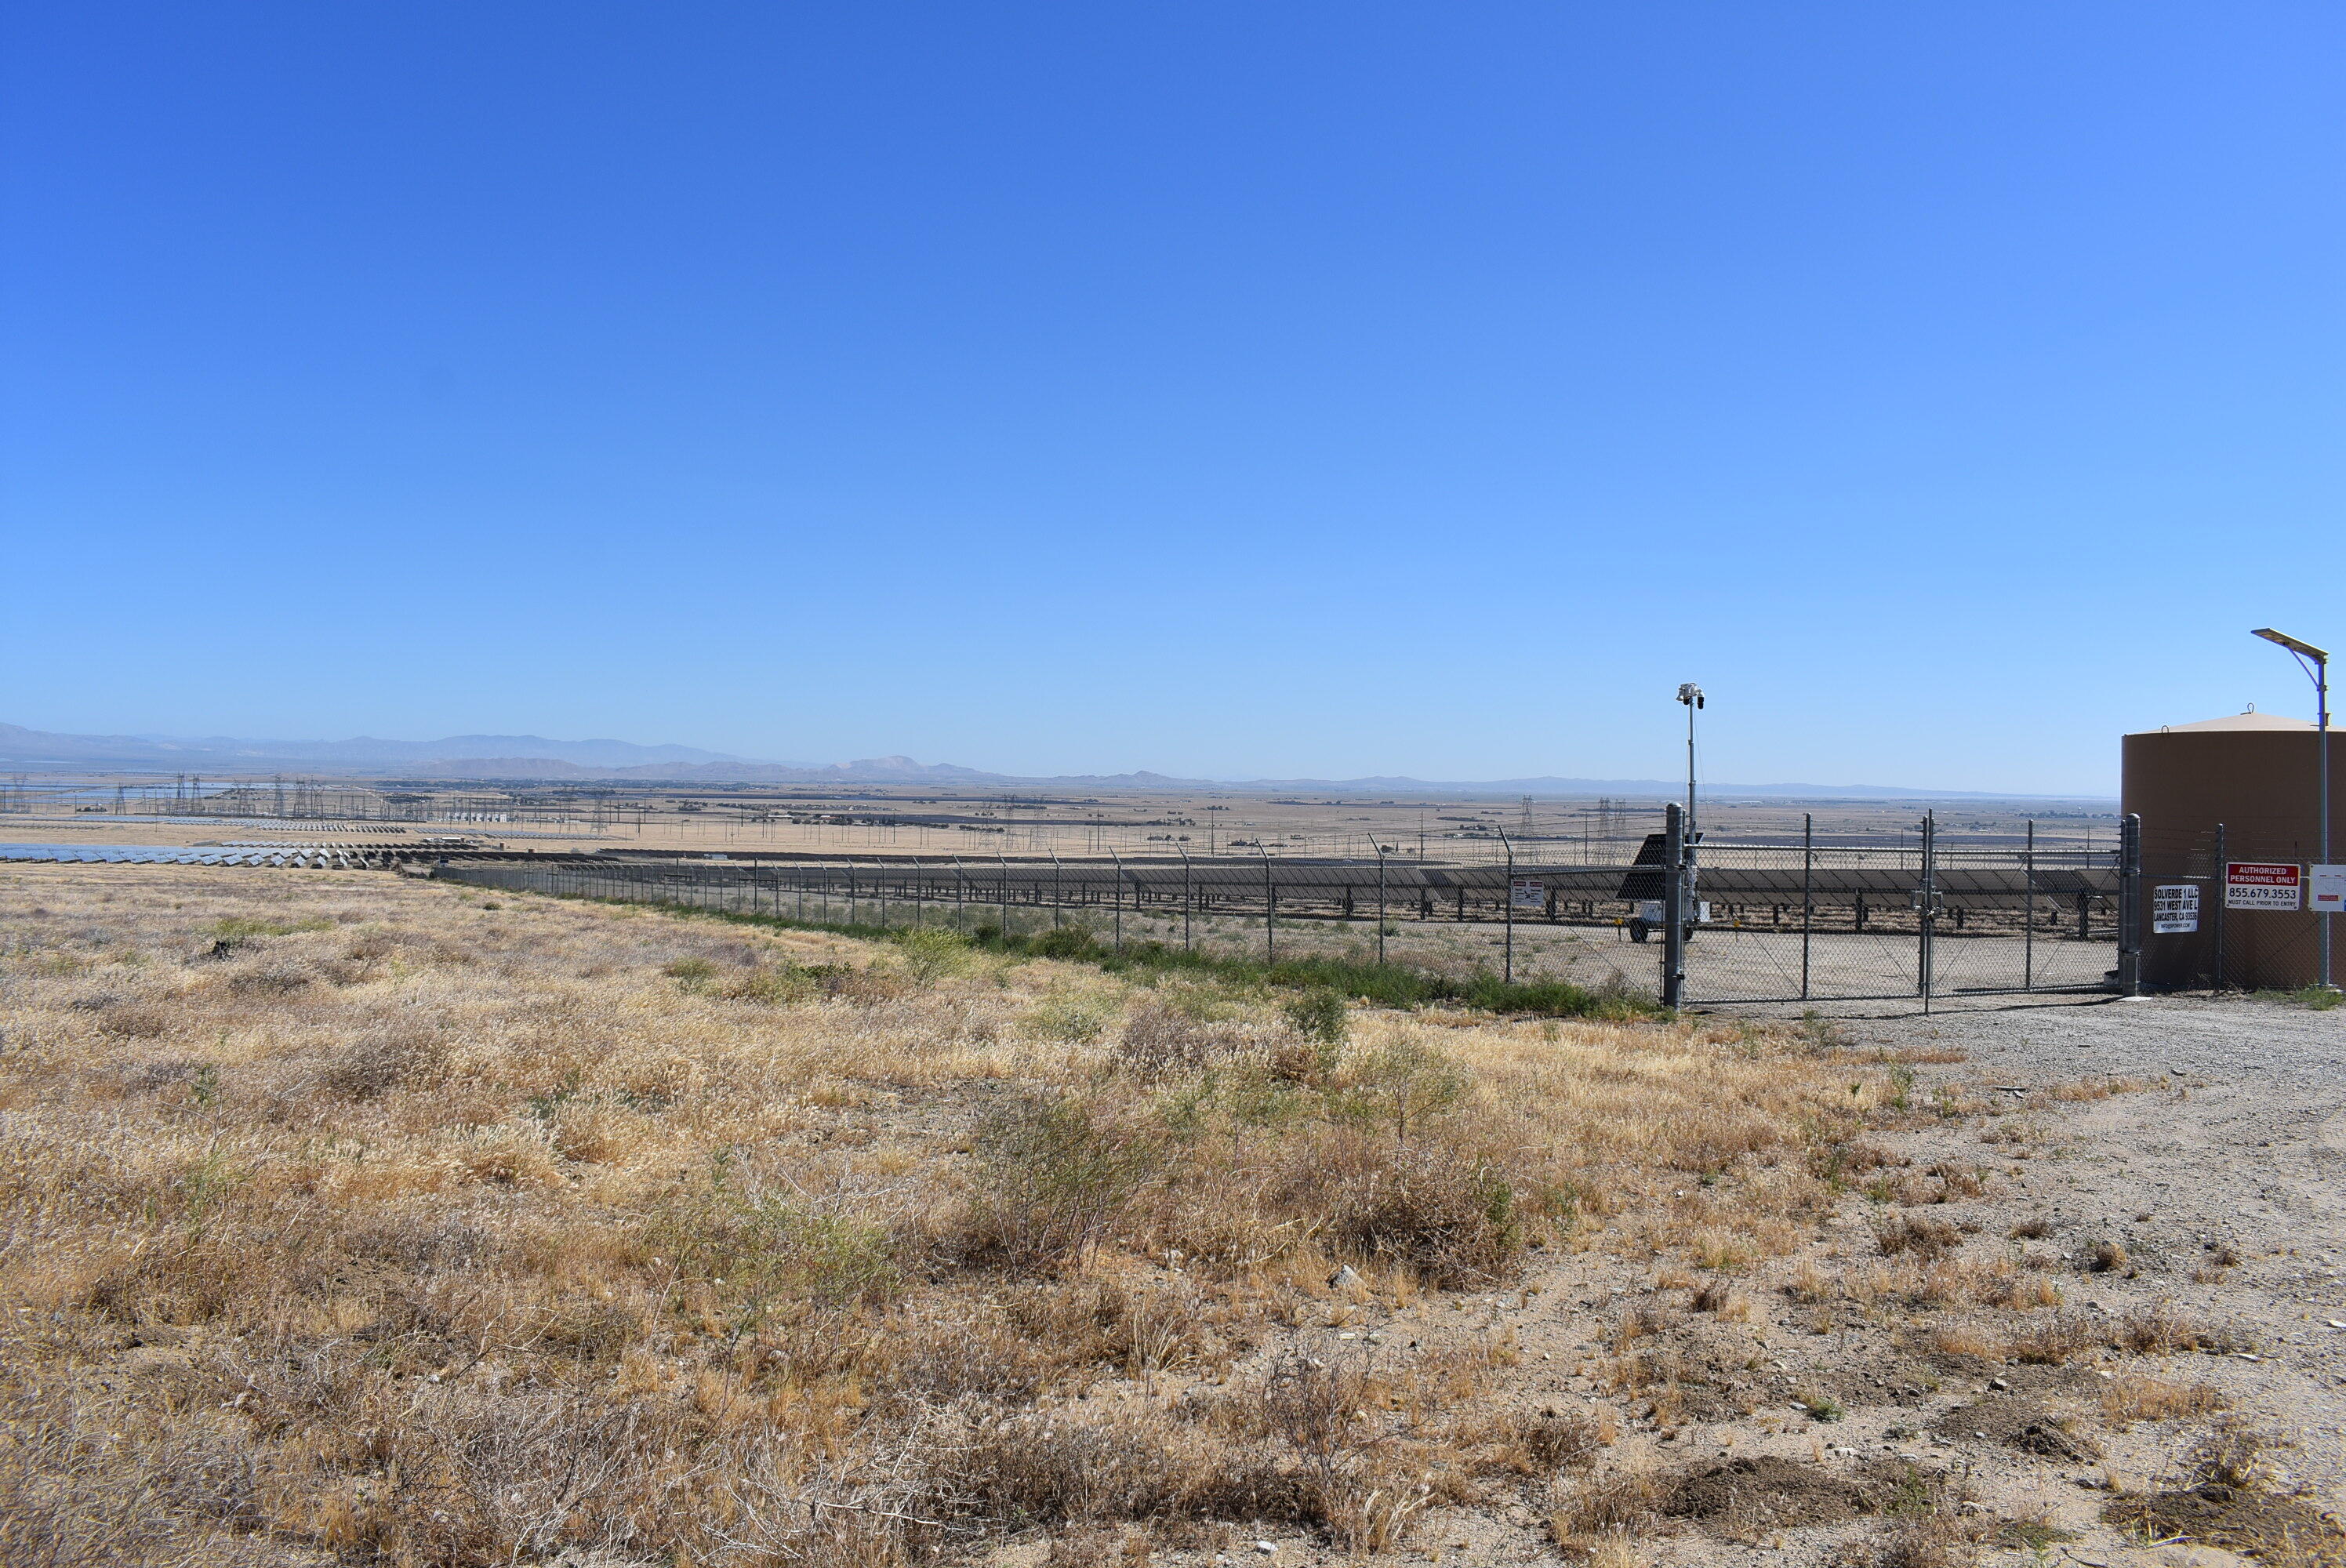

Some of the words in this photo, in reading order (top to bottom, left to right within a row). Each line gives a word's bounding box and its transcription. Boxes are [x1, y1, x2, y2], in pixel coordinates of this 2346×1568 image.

[2239, 866, 2286, 875] AUTHORIZED
[2154, 888, 2182, 899] SOLVERDE
[2184, 888, 2187, 898] 1
[2188, 888, 2198, 898] LLC
[2229, 887, 2296, 898] 855.679.3553
[2154, 900, 2166, 911] 9531
[2166, 900, 2181, 910] WEST
[2182, 900, 2193, 910] AVE
[2194, 900, 2198, 909] L
[2179, 912, 2184, 921] CA
